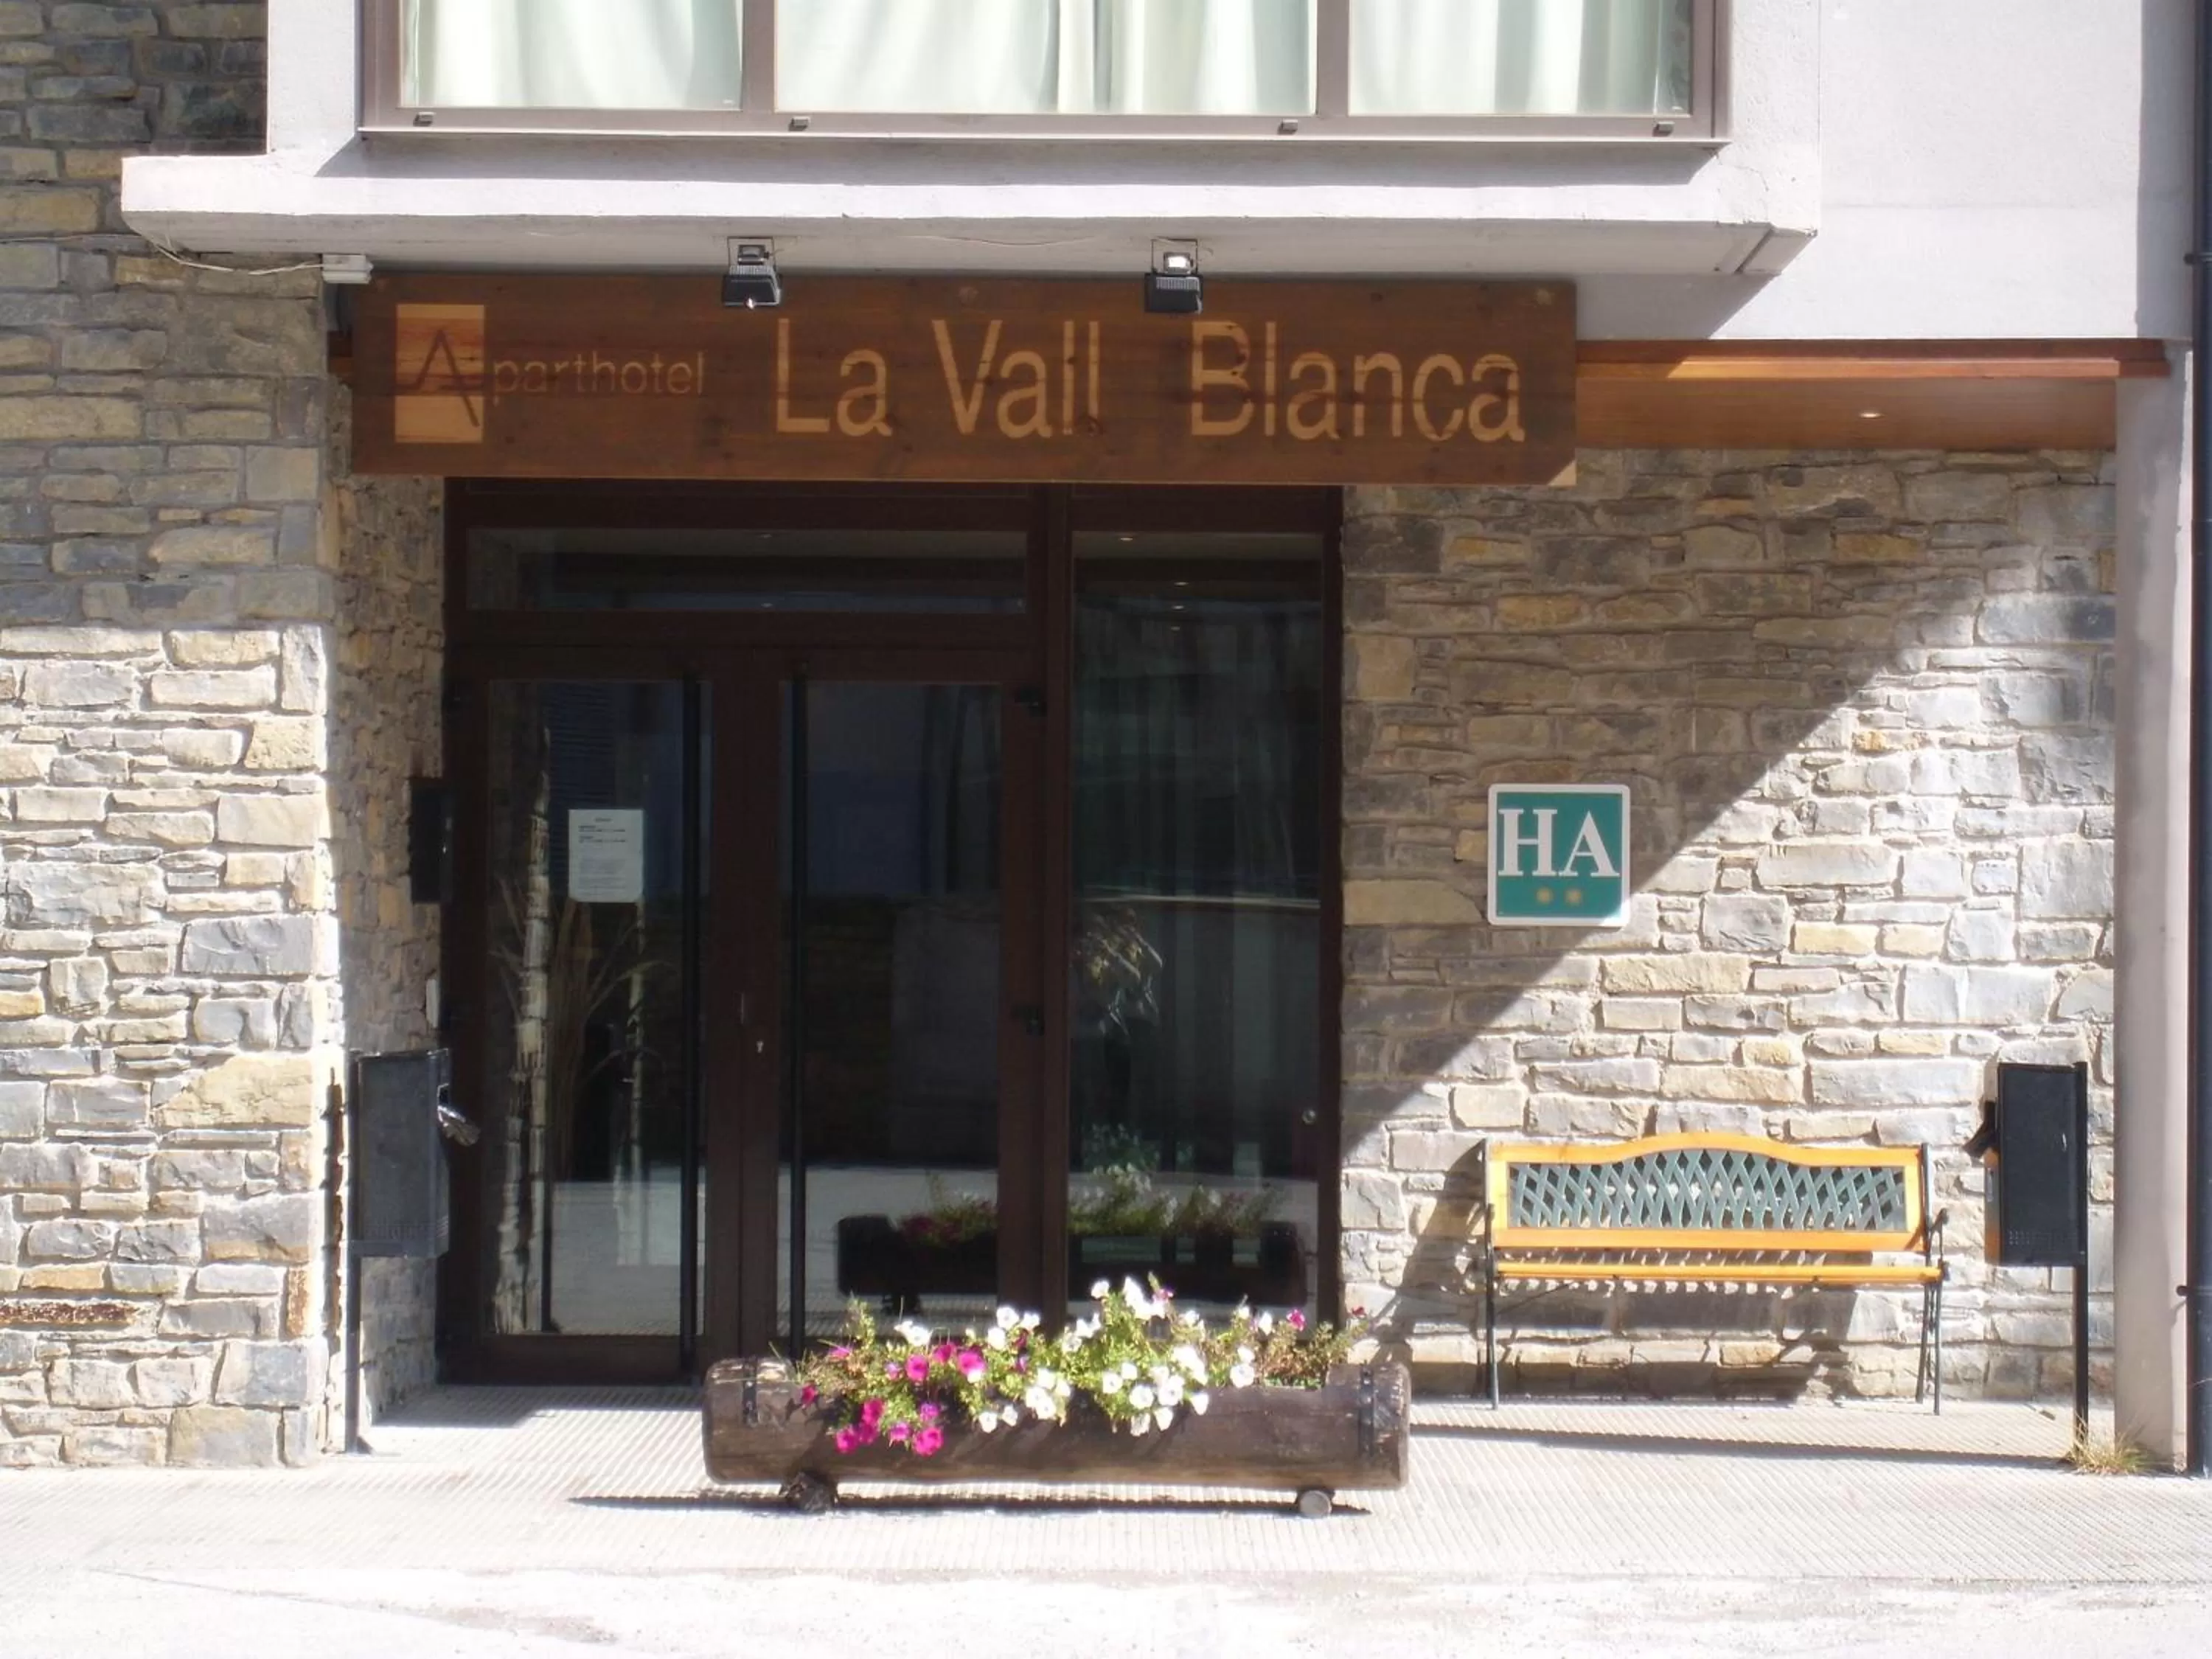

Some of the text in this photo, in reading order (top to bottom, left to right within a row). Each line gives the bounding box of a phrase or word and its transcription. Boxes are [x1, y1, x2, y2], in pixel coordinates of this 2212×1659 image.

[776, 318, 891, 437] La
[932, 319, 1101, 437] Vall
[1190, 320, 1526, 442] Blanca
[1498, 809, 1620, 877] HA
